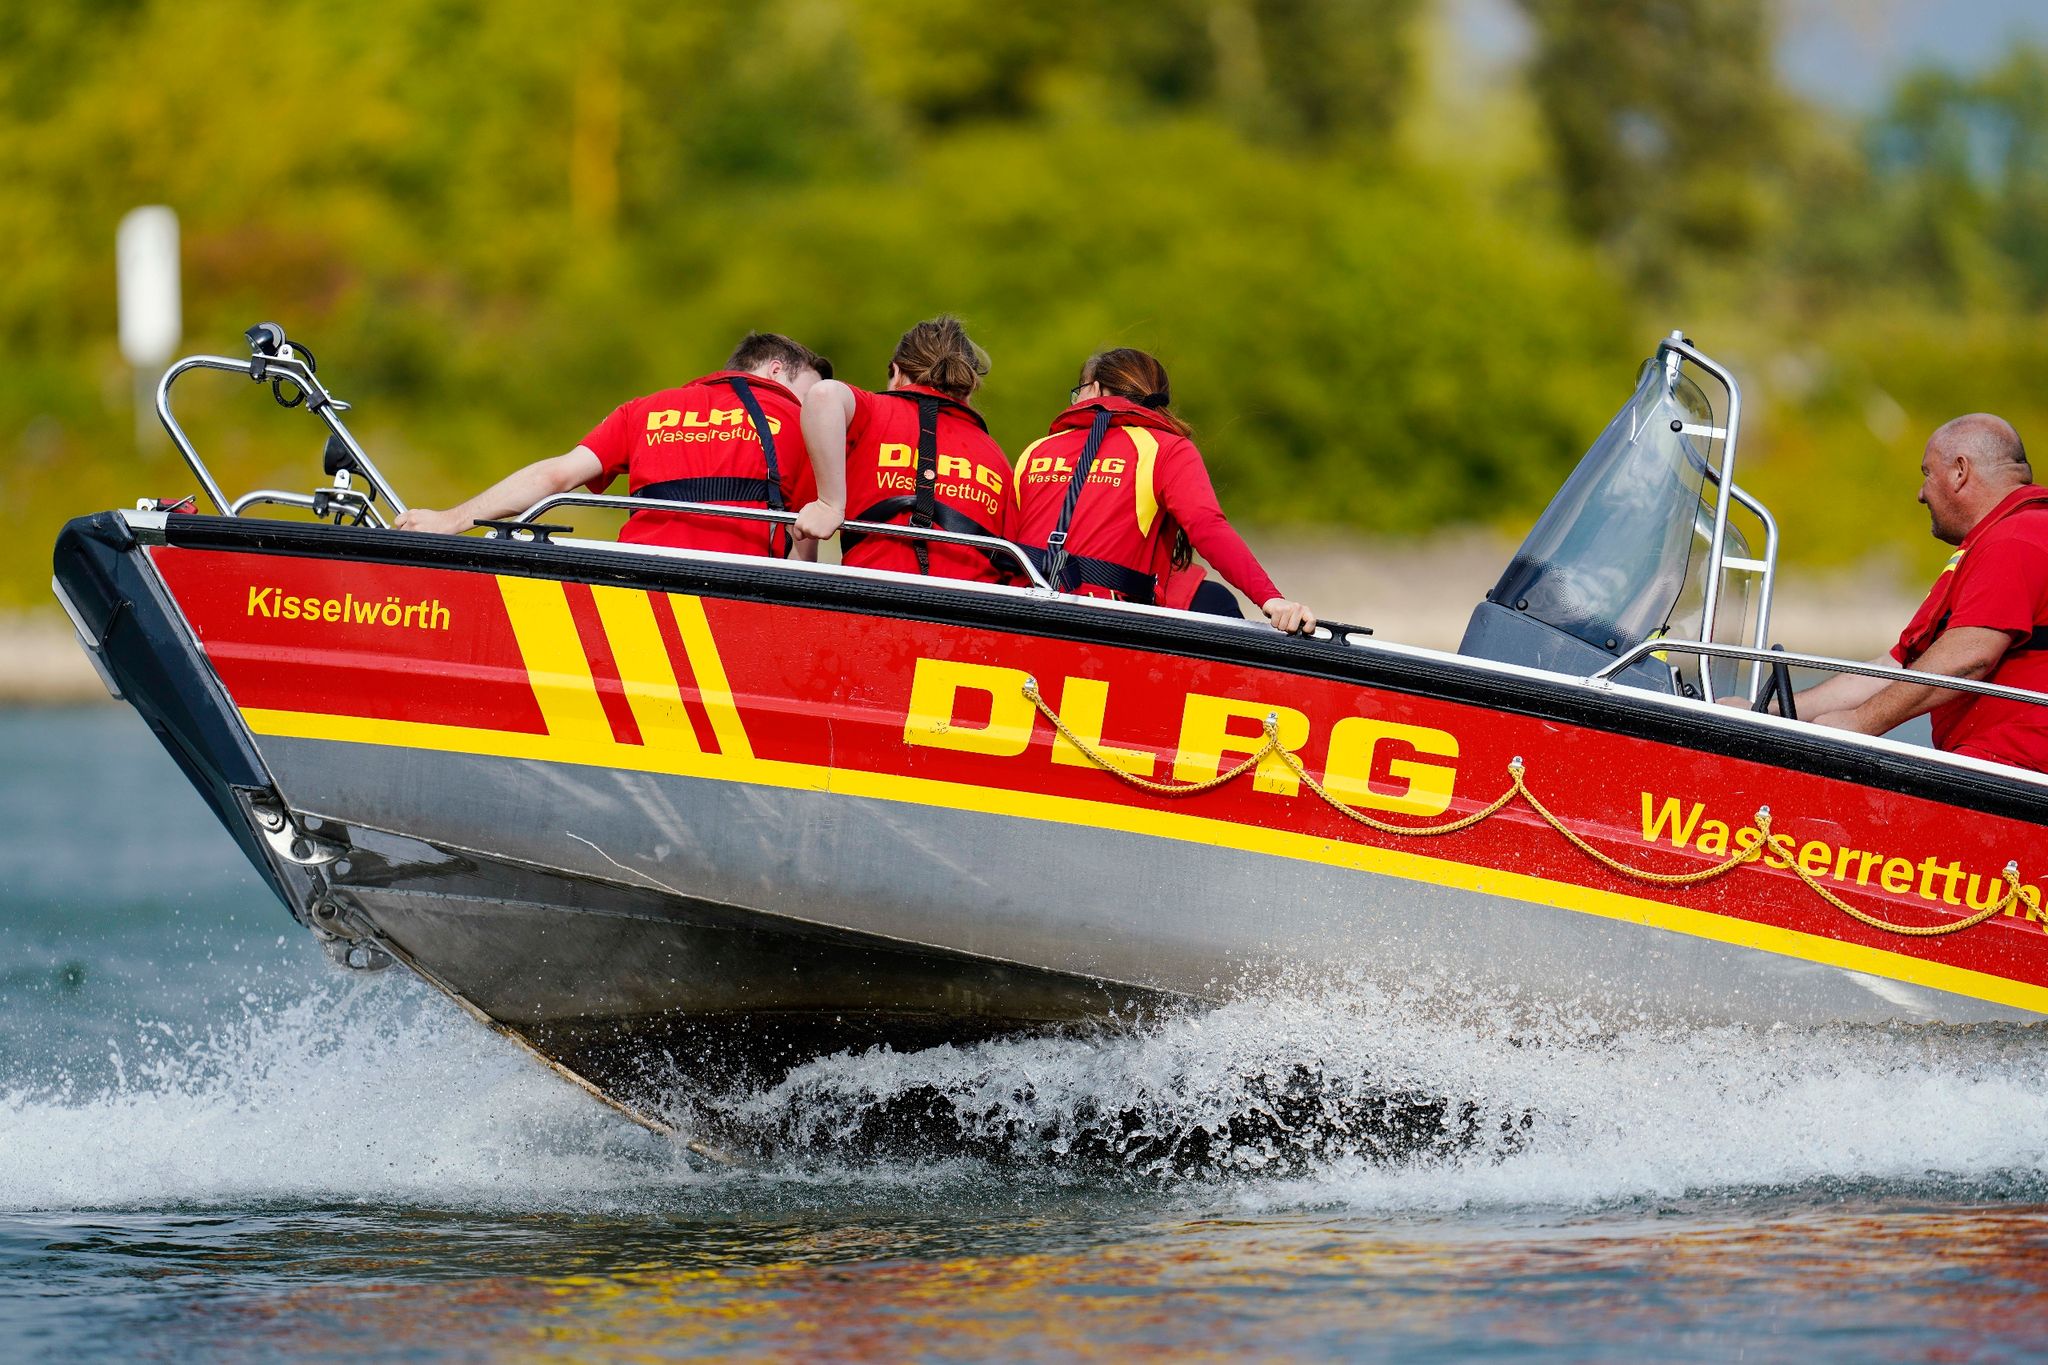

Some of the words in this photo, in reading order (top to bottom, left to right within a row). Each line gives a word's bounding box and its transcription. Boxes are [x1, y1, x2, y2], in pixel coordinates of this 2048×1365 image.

[646, 426, 766, 451] Wasserrettun
[876, 471, 999, 515] Wassrrettung
[1028, 474, 1122, 488] Wasserttung
[247, 586, 451, 631] Kisselwörth
[903, 657, 1460, 818] DLRG
[1641, 792, 2048, 936] Wasserrettun
